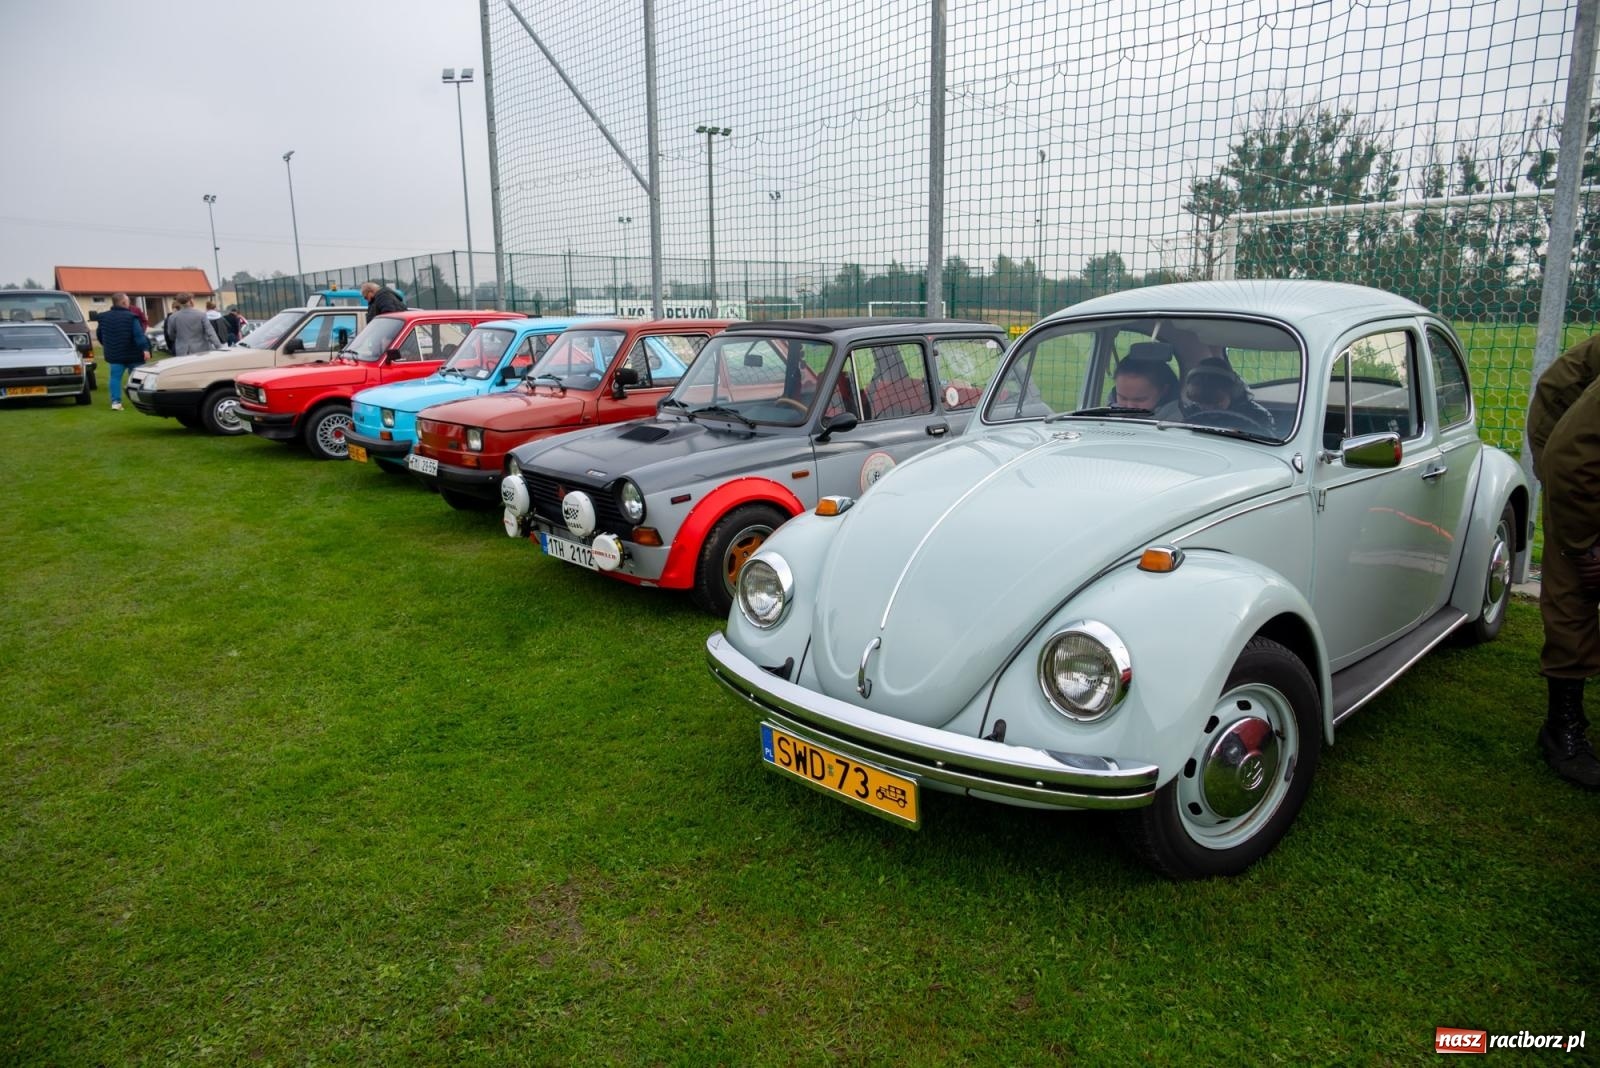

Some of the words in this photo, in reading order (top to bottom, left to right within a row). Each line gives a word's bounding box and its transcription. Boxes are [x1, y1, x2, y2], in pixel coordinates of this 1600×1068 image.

[549, 538, 565, 557] 1TH
[570, 544, 594, 567] 2112
[765, 747, 774, 758] PL
[777, 736, 826, 781] SWD
[835, 758, 869, 799] 73
